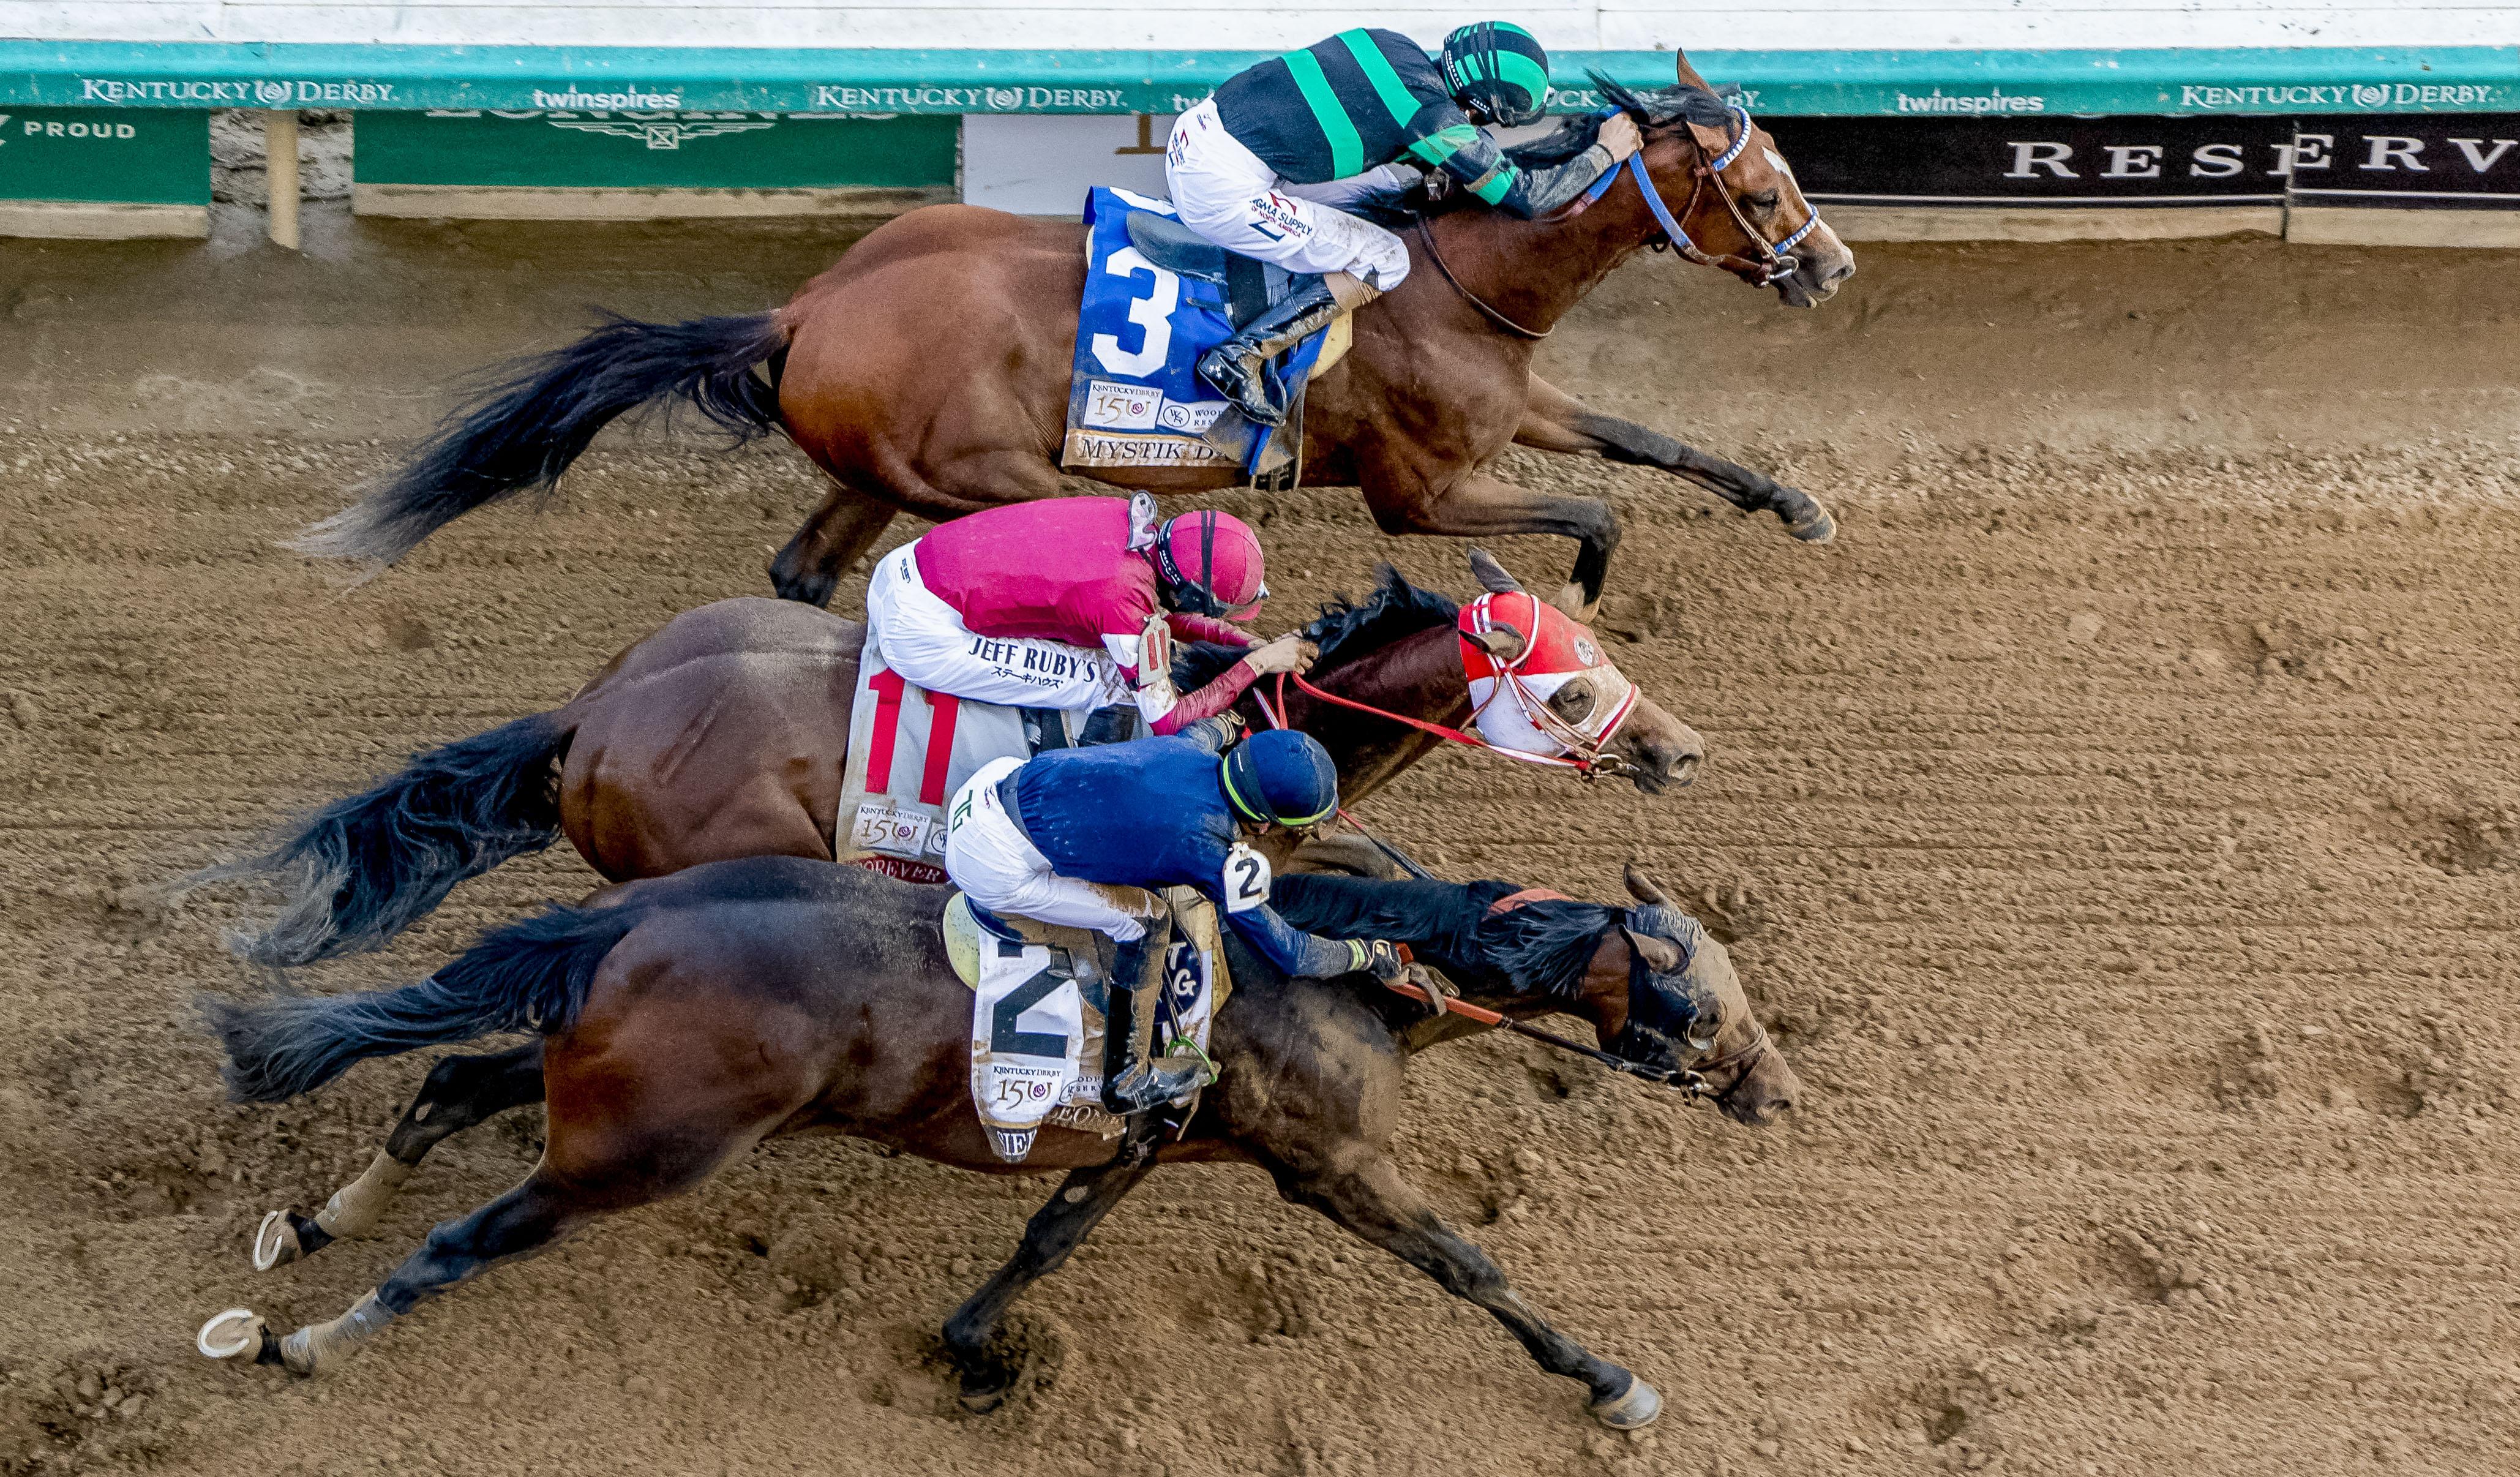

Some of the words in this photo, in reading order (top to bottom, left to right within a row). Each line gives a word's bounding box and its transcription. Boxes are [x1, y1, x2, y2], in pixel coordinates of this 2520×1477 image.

[81, 79, 249, 102] KENTUCKY
[297, 80, 394, 103] DERBY
[533, 83, 681, 109] twinspires
[817, 86, 980, 108] KENTUCKY
[1029, 88, 1123, 108] DERBY
[1898, 87, 2045, 114] twinspires
[2180, 85, 2347, 109] KENTUCKY
[2394, 84, 2492, 105] DERBY
[23, 121, 137, 139] PROUD
[1278, 212, 1313, 236] SUPPLY
[1092, 246, 1180, 378] 3
[1092, 383, 1134, 395] KENTUCKY
[1081, 437, 1185, 459] MYSTIK
[968, 636, 1019, 664] JEFF
[1023, 647, 1097, 683] RUBY'S
[864, 667, 960, 806] 11
[860, 859, 940, 882] OREVER
[1234, 857, 1262, 900] 2
[990, 941, 1069, 1059] 2
[993, 1065, 1036, 1077] KENTUCKY
